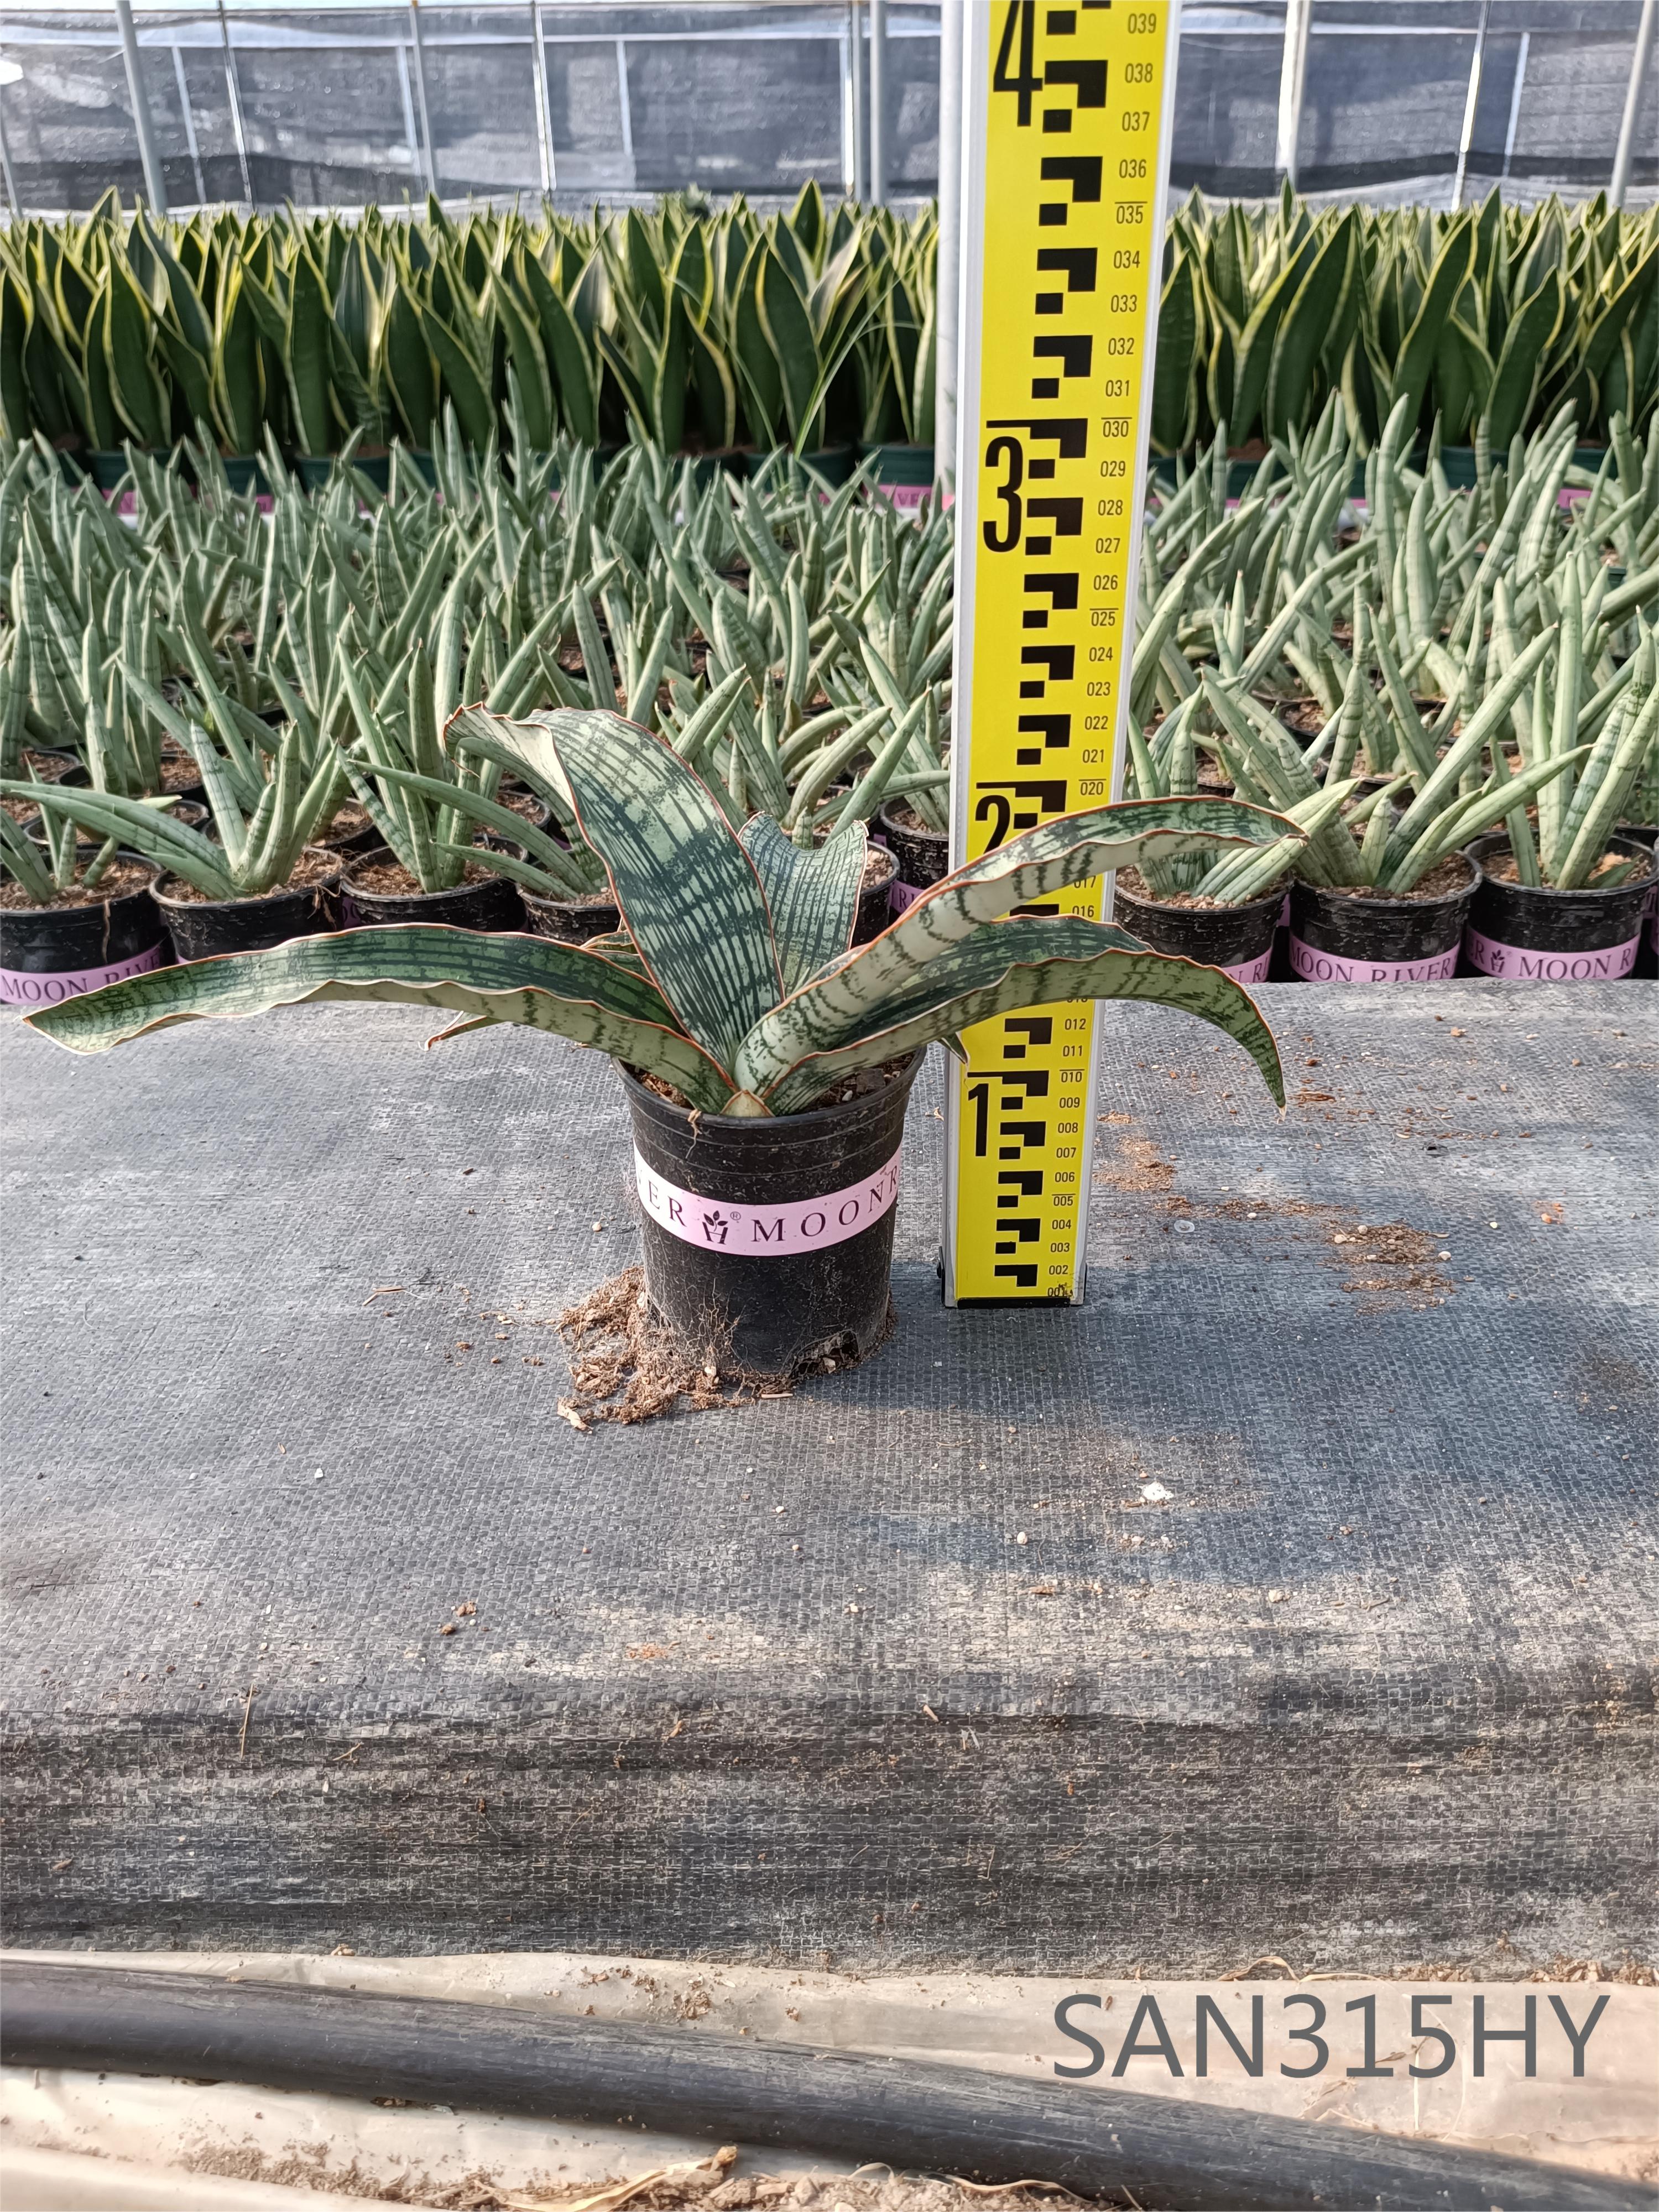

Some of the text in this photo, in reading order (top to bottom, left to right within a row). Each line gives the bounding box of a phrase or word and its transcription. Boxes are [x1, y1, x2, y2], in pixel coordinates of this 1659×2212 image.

[1127, 13, 1157, 34] 039
[993, 0, 1043, 127] 4
[1124, 62, 1154, 84] 038
[1121, 111, 1150, 132] 037
[1119, 159, 1147, 179] 036
[1116, 205, 1144, 225] 035
[1113, 250, 1140, 269] 034
[1110, 294, 1138, 313] 033
[1108, 337, 1135, 356] 032
[1105, 379, 1130, 397] 031
[1103, 420, 1129, 438] 030
[1100, 460, 1126, 477] 029
[983, 436, 1023, 552] 3
[1098, 499, 1123, 516] 028
[1095, 538, 1121, 554] 027
[1093, 575, 1118, 591] 026
[1091, 611, 1115, 627] 025
[1089, 646, 1113, 662] 024
[1087, 681, 1111, 697] 023
[1084, 715, 1109, 731] 022
[1082, 749, 1104, 764] 021
[1080, 781, 1104, 796] 020
[975, 795, 1011, 855] 2
[1518, 954, 1612, 980] MOON
[1, 974, 88, 1002] MOON
[1065, 1018, 1087, 1030] 012
[1062, 1045, 1082, 1057] 011
[1061, 1071, 1082, 1083] 010
[1059, 1097, 1081, 1109] 009
[968, 1083, 989, 1156] 1
[1057, 1122, 1078, 1134] 008
[1056, 1147, 1077, 1159] 007
[1055, 1171, 1075, 1183] 006
[1053, 1196, 1073, 1207] 005
[1052, 1219, 1072, 1230] 004
[1050, 1242, 1070, 1253] 003
[1048, 1265, 1068, 1275] 002
